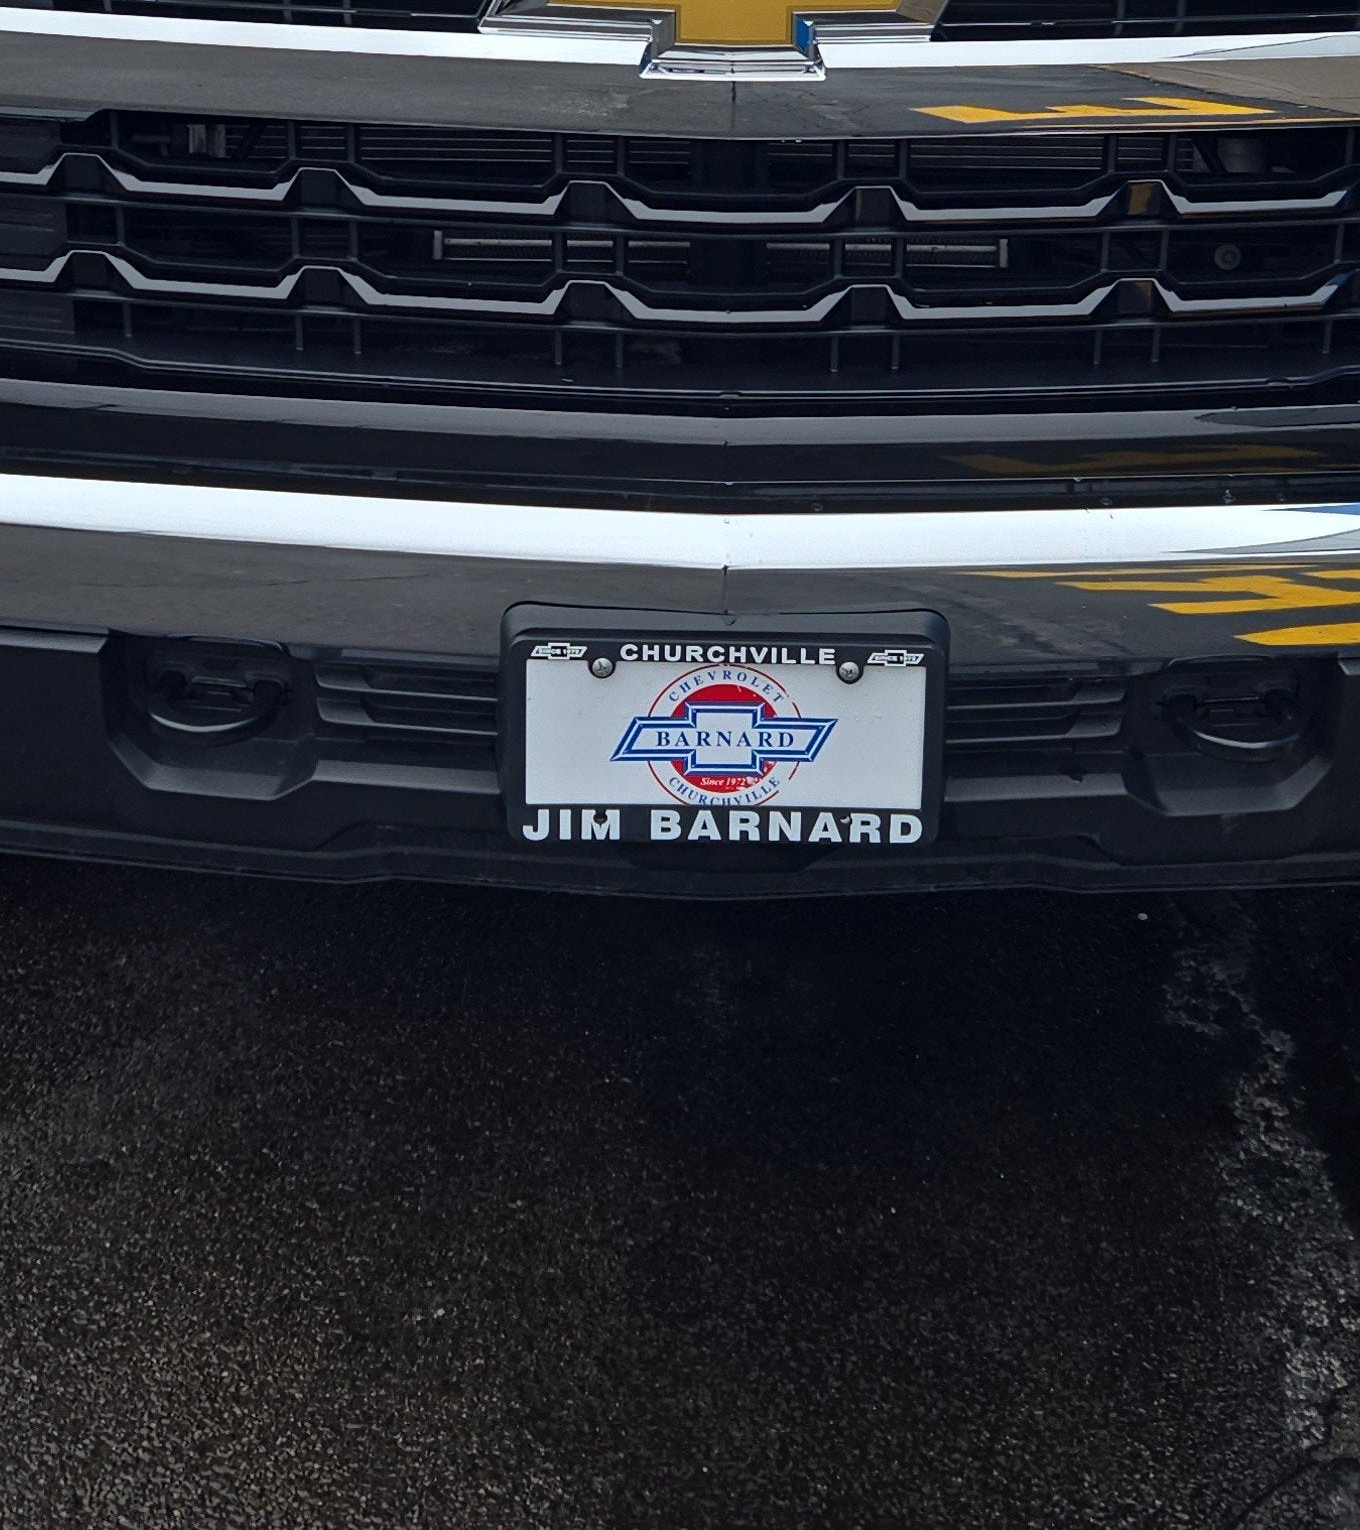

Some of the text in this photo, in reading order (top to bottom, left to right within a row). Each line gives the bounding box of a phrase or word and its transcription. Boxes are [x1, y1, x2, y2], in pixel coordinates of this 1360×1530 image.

[619, 643, 836, 665] CHURCHVILLE
[668, 669, 785, 704] CHEVROLET
[655, 730, 794, 748] BARNARD
[668, 776, 781, 806] CHURCHVILLE
[700, 776, 746, 787] Since 1972
[521, 807, 924, 845] JIM BARNARD
